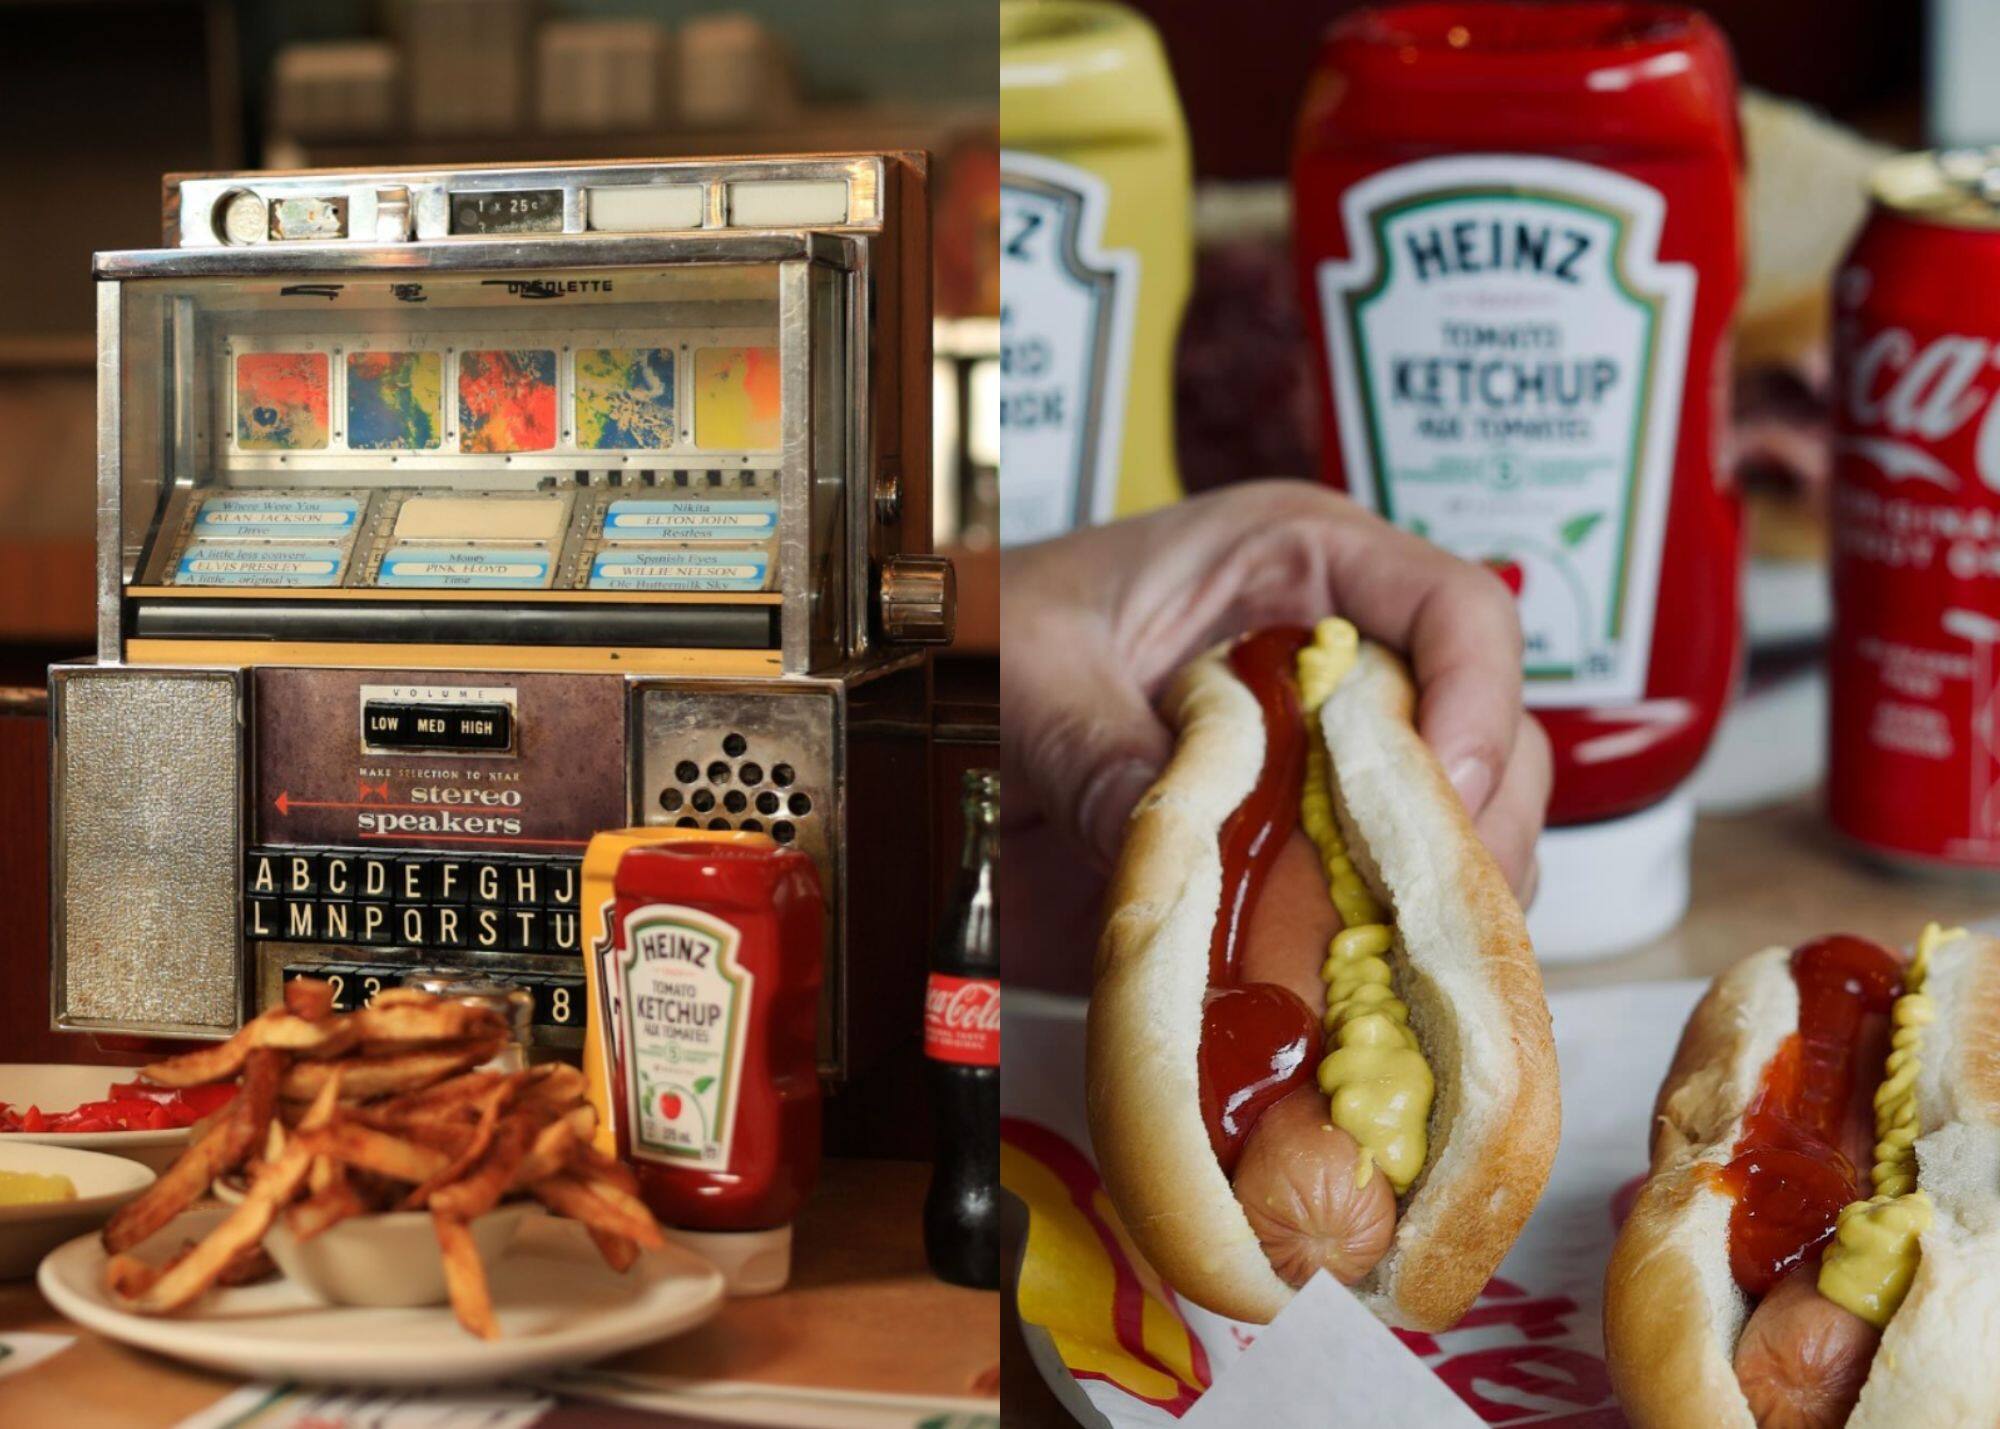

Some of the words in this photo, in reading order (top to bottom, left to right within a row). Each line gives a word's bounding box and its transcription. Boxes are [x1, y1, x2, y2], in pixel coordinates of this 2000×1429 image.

[1406, 219, 1592, 284] HEINZ
[1393, 359, 1619, 406] KETCHUP
[224, 502, 259, 511] Where
[264, 503, 295, 511] Were
[296, 503, 320, 511] You
[672, 503, 711, 513] Nikita
[215, 513, 251, 522] ALAN
[260, 513, 322, 522] JACKSON
[646, 515, 695, 524] ELTON
[700, 515, 739, 524] JOHN
[662, 529, 713, 538] Restless
[197, 562, 237, 571] ELVIS
[240, 562, 301, 571] PRESLEY
[636, 554, 685, 565] Spanish
[688, 554, 719, 566] Eyes
[425, 564, 456, 573] PINK
[462, 564, 508, 574] FLOYD
[622, 567, 672, 576] WILLIE
[676, 567, 738, 577] NELSON
[393, 689, 485, 698] VOLUME
[371, 716, 399, 731] LOW
[417, 719, 445, 733] MED
[461, 720, 493, 735] HIGH
[359, 767, 391, 777] MAKE
[400, 768, 459, 779] SELECTION
[467, 770, 480, 780] TO
[410, 784, 522, 807] stereo
[358, 811, 522, 835] speakers
[255, 858, 273, 891] A
[292, 858, 310, 891] B
[329, 859, 348, 893] C
[367, 861, 385, 895] D
[405, 865, 420, 898] E
[443, 865, 459, 897] F
[479, 866, 498, 900] G
[517, 868, 536, 902] H
[555, 868, 573, 903] J
[254, 901, 269, 934] L
[290, 903, 312, 936] M
[327, 905, 347, 938] N
[366, 906, 383, 940] P
[403, 908, 422, 943] Q
[441, 908, 458, 943] R
[479, 910, 497, 945] S
[517, 912, 535, 946] T
[555, 914, 574, 948] U
[641, 933, 710, 968] HEINZ
[652, 980, 696, 998] TOMATO
[327, 975, 345, 1009] 2
[552, 988, 569, 1022] 8
[637, 994, 721, 1027] KETCHUP
